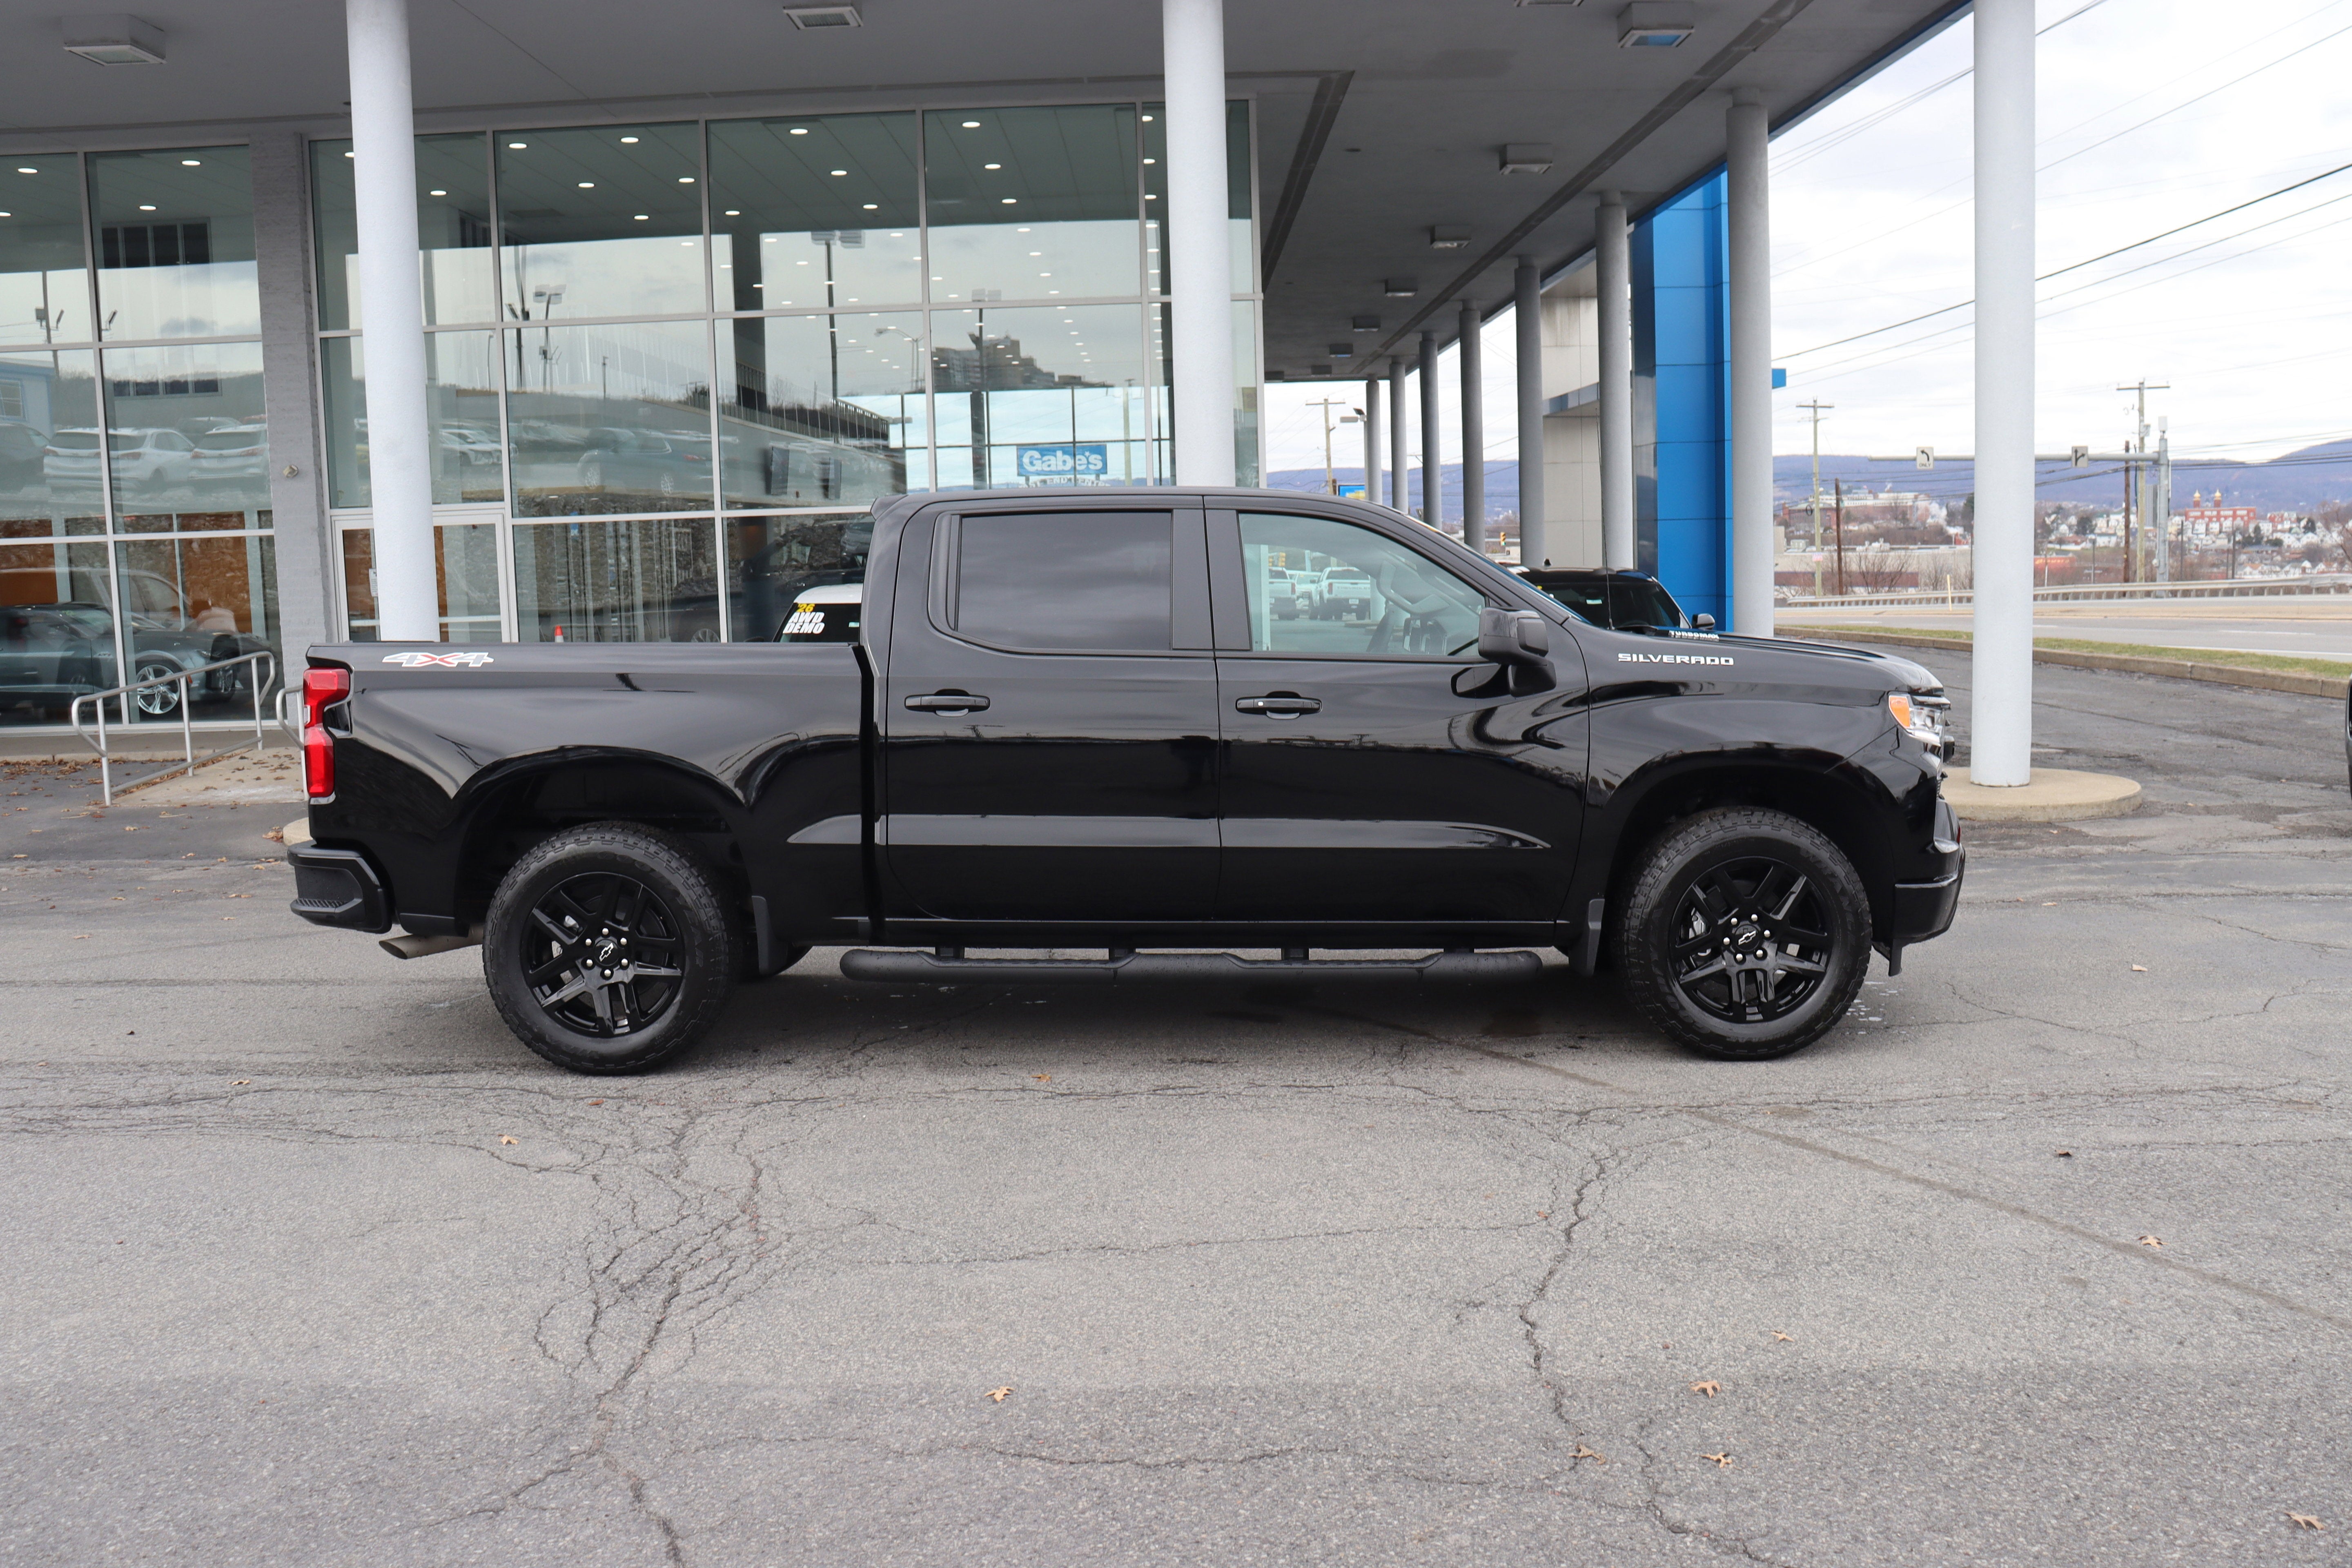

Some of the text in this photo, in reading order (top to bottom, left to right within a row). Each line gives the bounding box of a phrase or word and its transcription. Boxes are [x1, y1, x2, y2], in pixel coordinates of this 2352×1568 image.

[1022, 450, 1102, 471] Gabe's
[797, 604, 815, 612] '26
[788, 612, 825, 623] AWD
[782, 623, 825, 634] DEMO
[1618, 653, 1734, 666] SILVERADO
